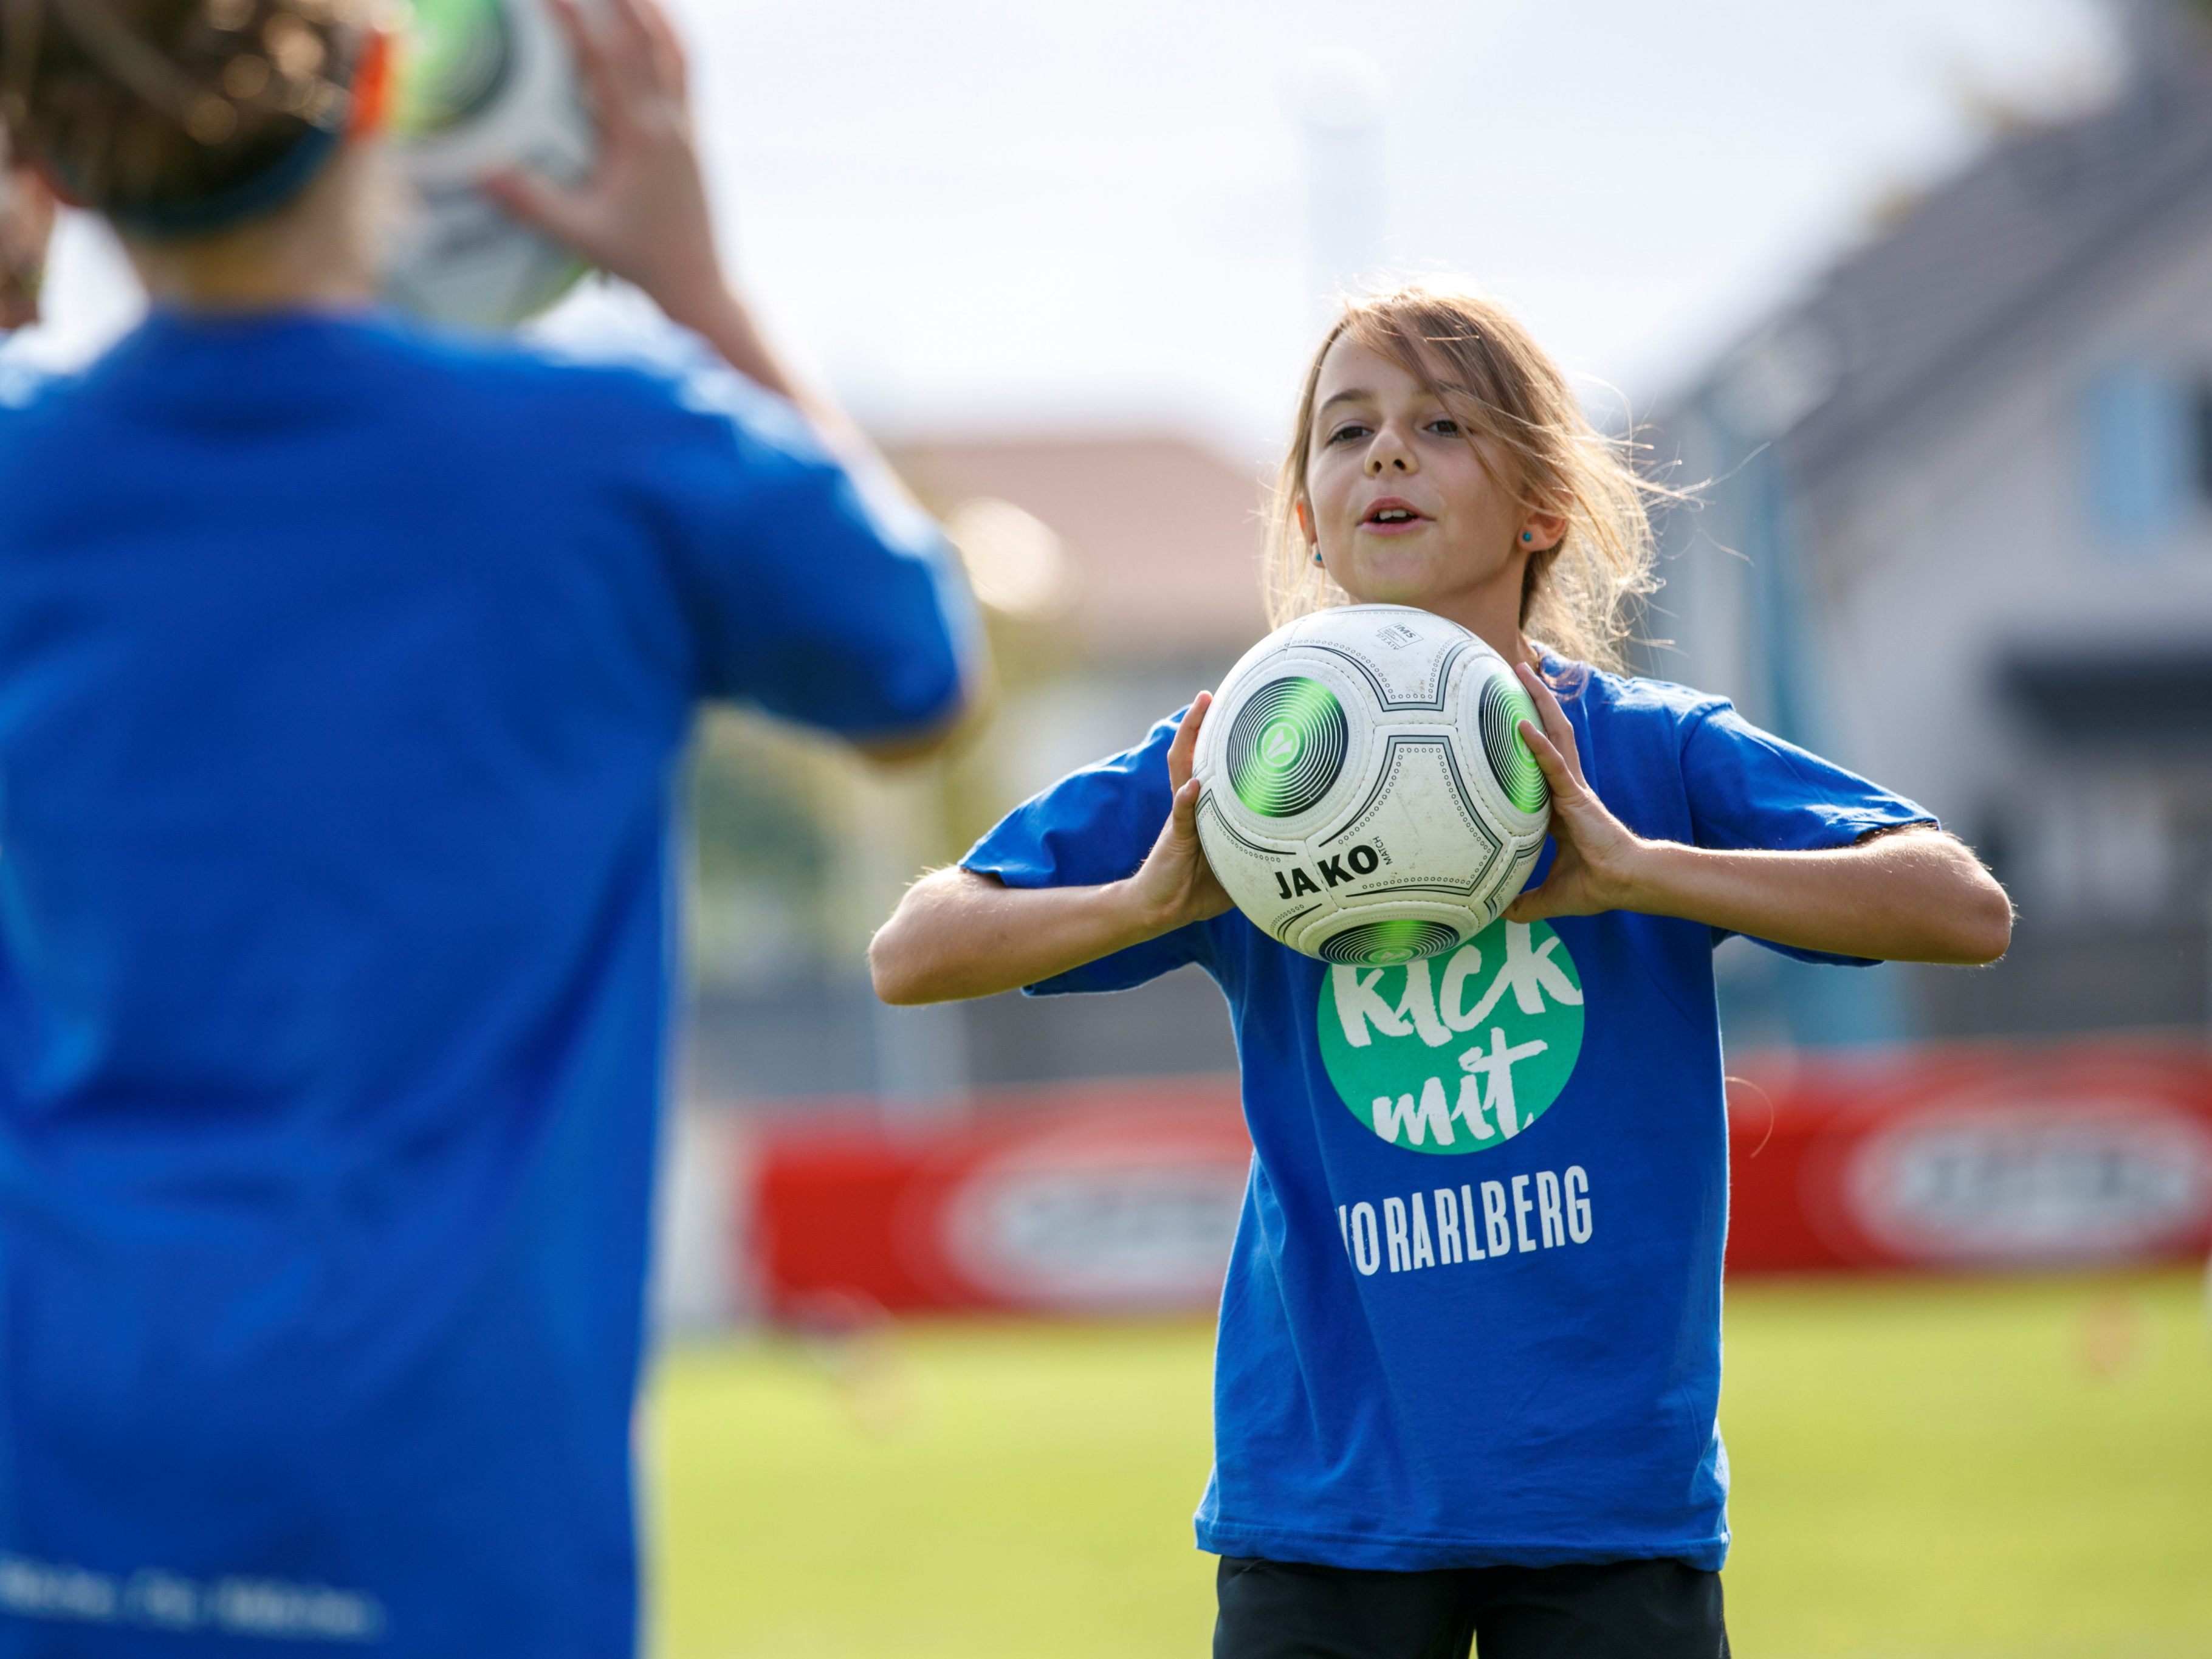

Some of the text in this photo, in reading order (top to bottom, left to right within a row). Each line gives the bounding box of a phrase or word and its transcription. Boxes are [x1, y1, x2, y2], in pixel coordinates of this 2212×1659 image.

[1394, 624, 1417, 638] IMS
[1372, 836, 1393, 865] MATCH
[1274, 845, 1379, 899] JAKO
